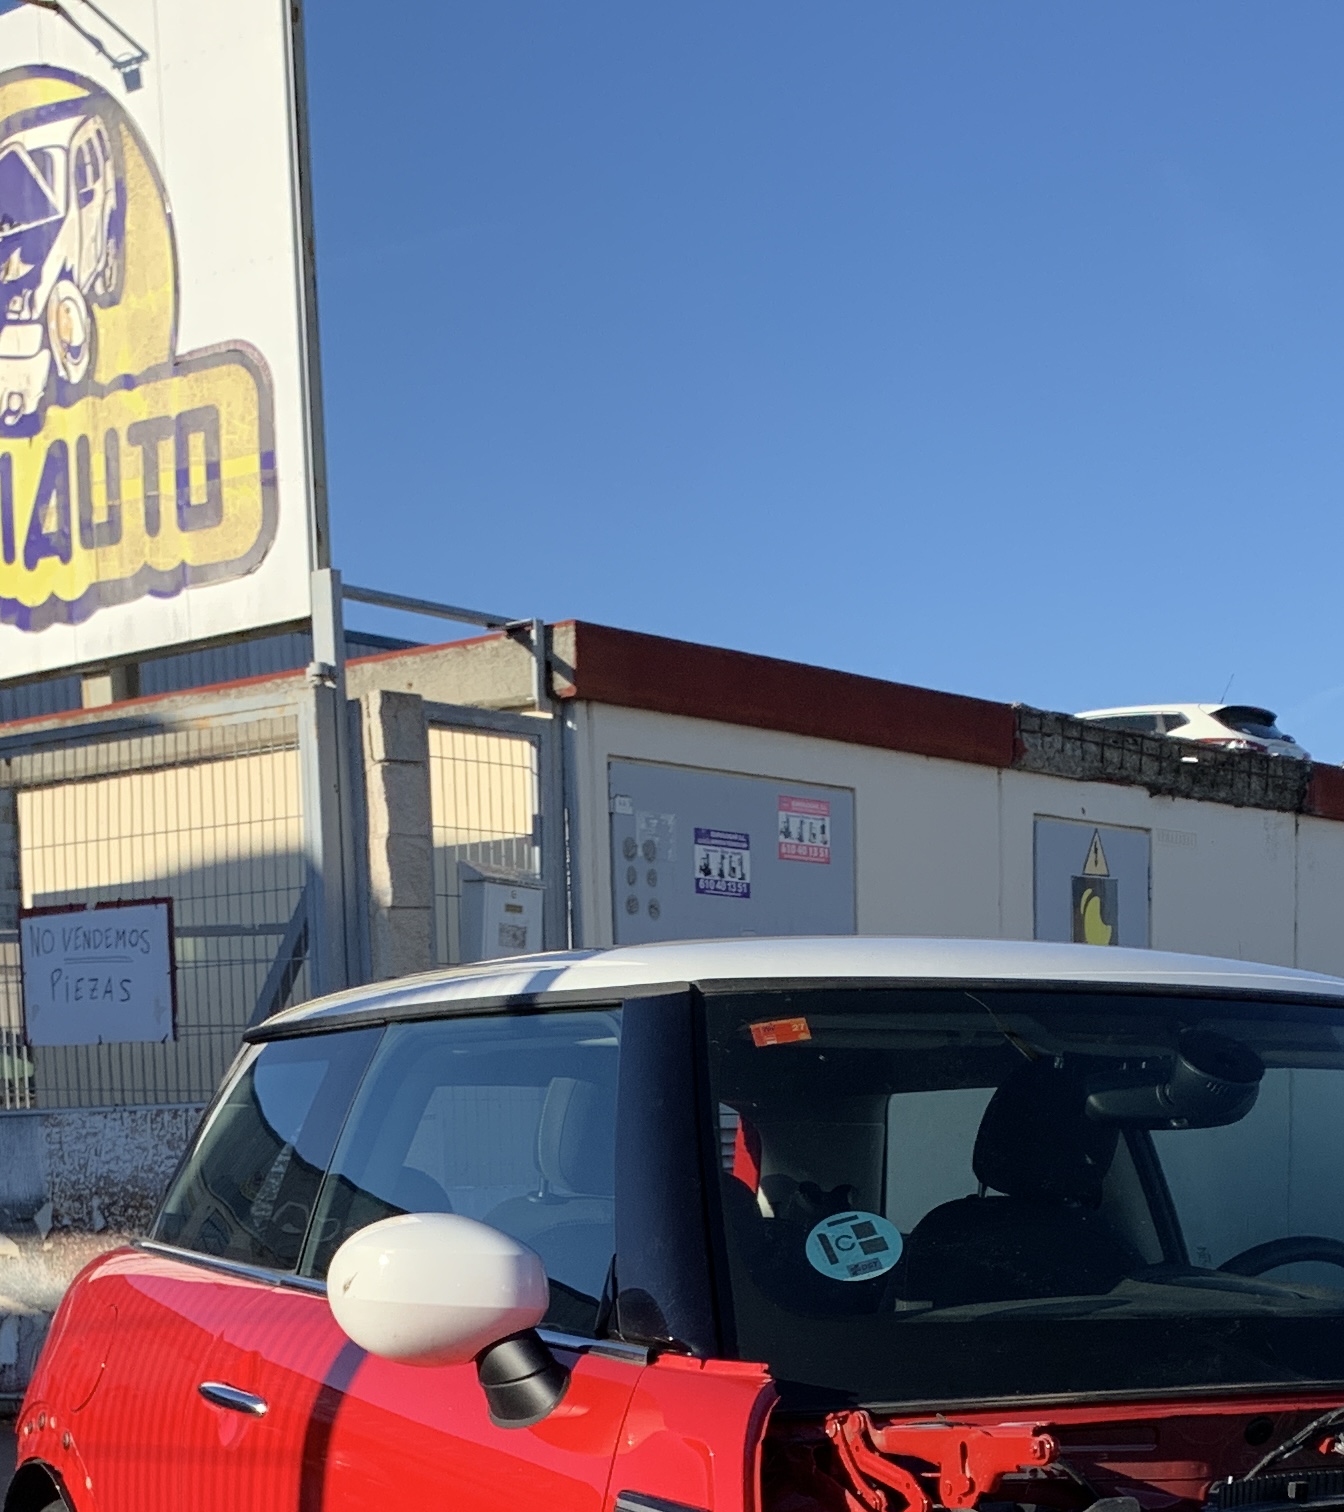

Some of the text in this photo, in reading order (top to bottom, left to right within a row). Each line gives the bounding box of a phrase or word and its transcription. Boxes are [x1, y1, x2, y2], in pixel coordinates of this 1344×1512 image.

[781, 844, 796, 854] 610
[809, 847, 818, 857] 13
[699, 879, 747, 892] 610 40 13 51
[30, 926, 151, 956] NO VENDEMOS
[835, 1234, 856, 1251] C
